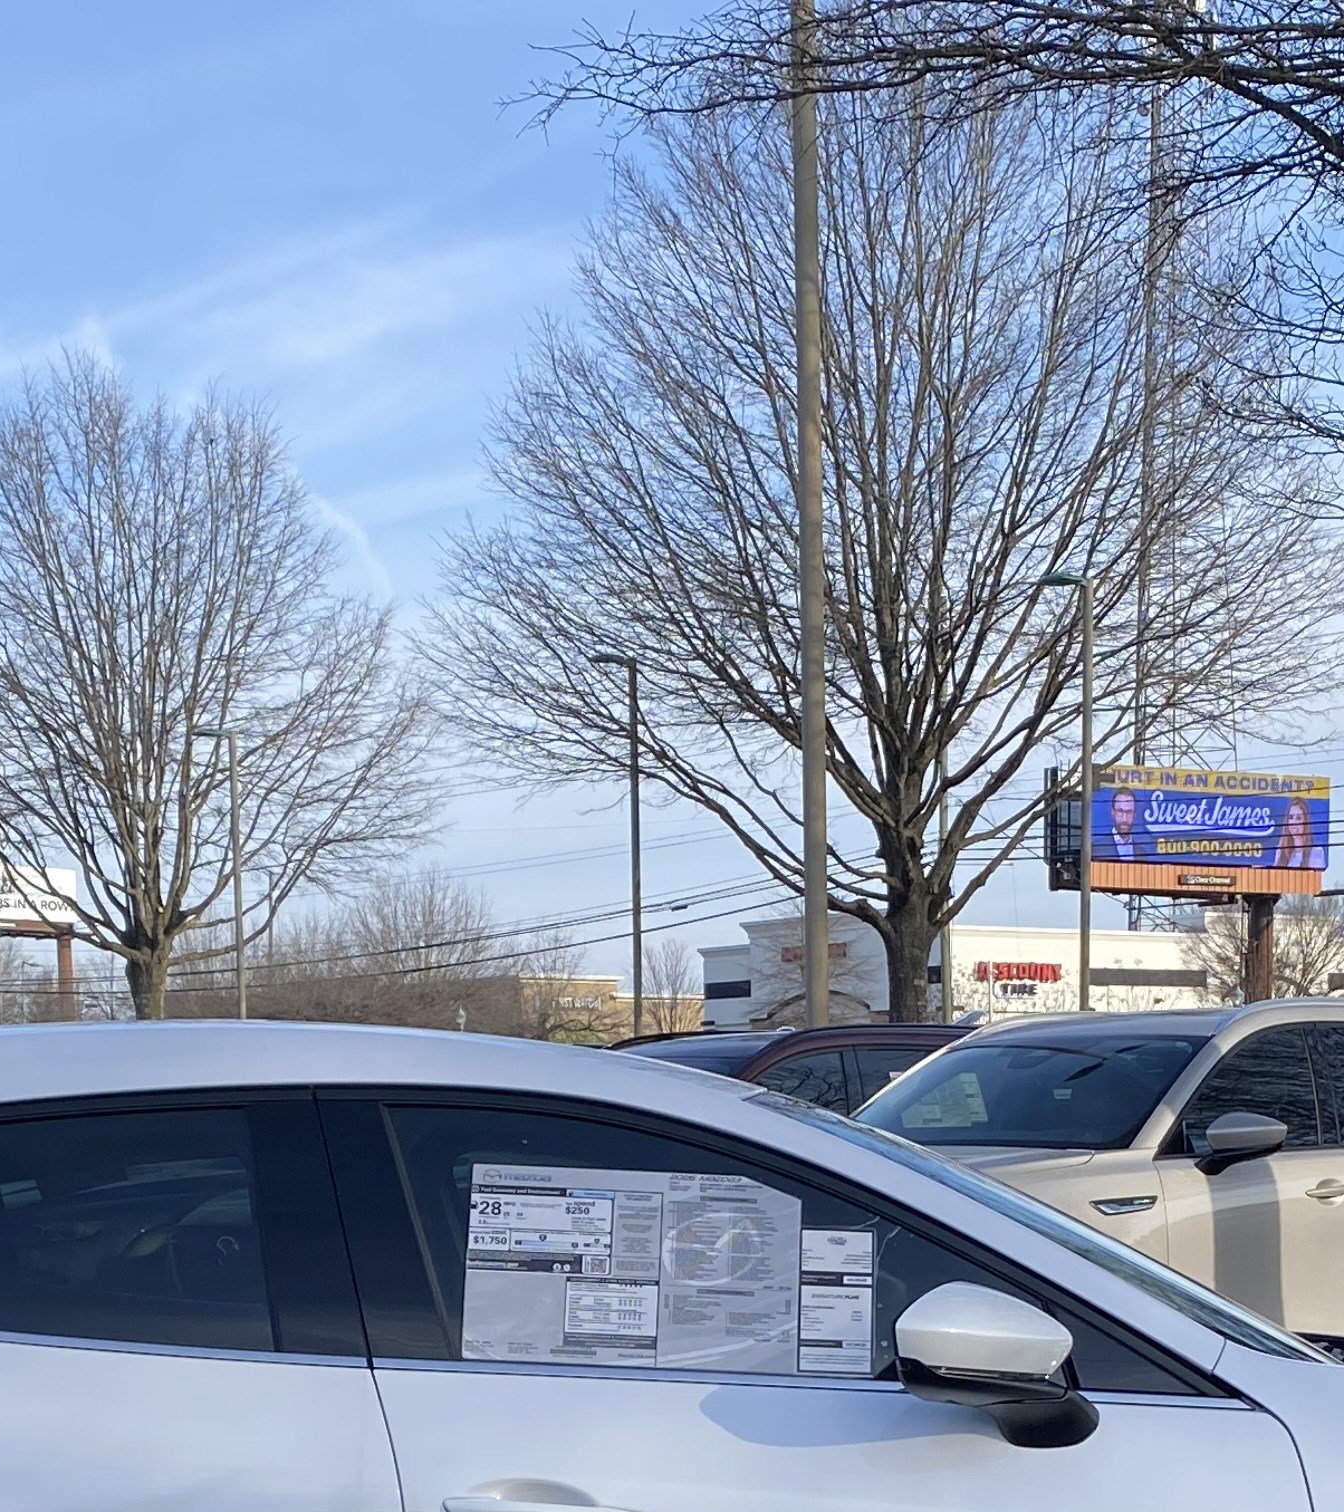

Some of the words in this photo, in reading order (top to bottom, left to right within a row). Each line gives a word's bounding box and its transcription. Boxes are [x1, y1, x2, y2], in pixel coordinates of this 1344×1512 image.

[1160, 772, 1177, 787] IN
[1183, 774, 1208, 788] AN
[1144, 791, 1207, 825] Sweet
[478, 1200, 502, 1216] 28
[565, 1205, 590, 1215] $250
[473, 1235, 508, 1246] $1,750
